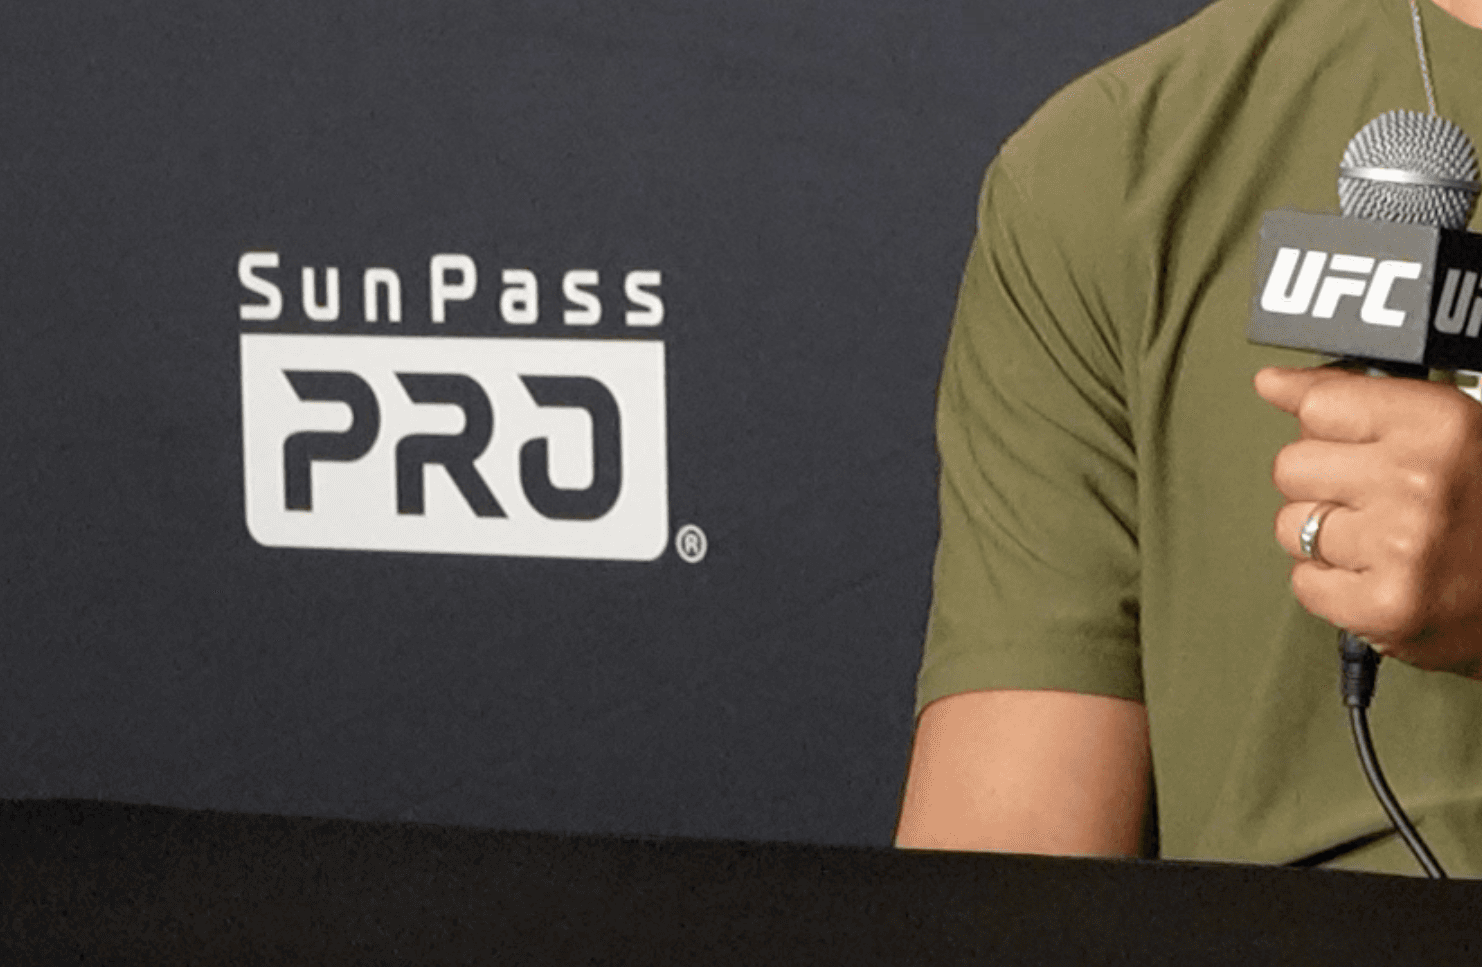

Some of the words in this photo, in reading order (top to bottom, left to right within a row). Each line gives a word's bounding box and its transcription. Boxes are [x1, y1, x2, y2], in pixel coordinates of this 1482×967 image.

[238, 252, 664, 327] SunPass
[1260, 247, 1422, 327] UFC
[281, 368, 623, 522] PRO
